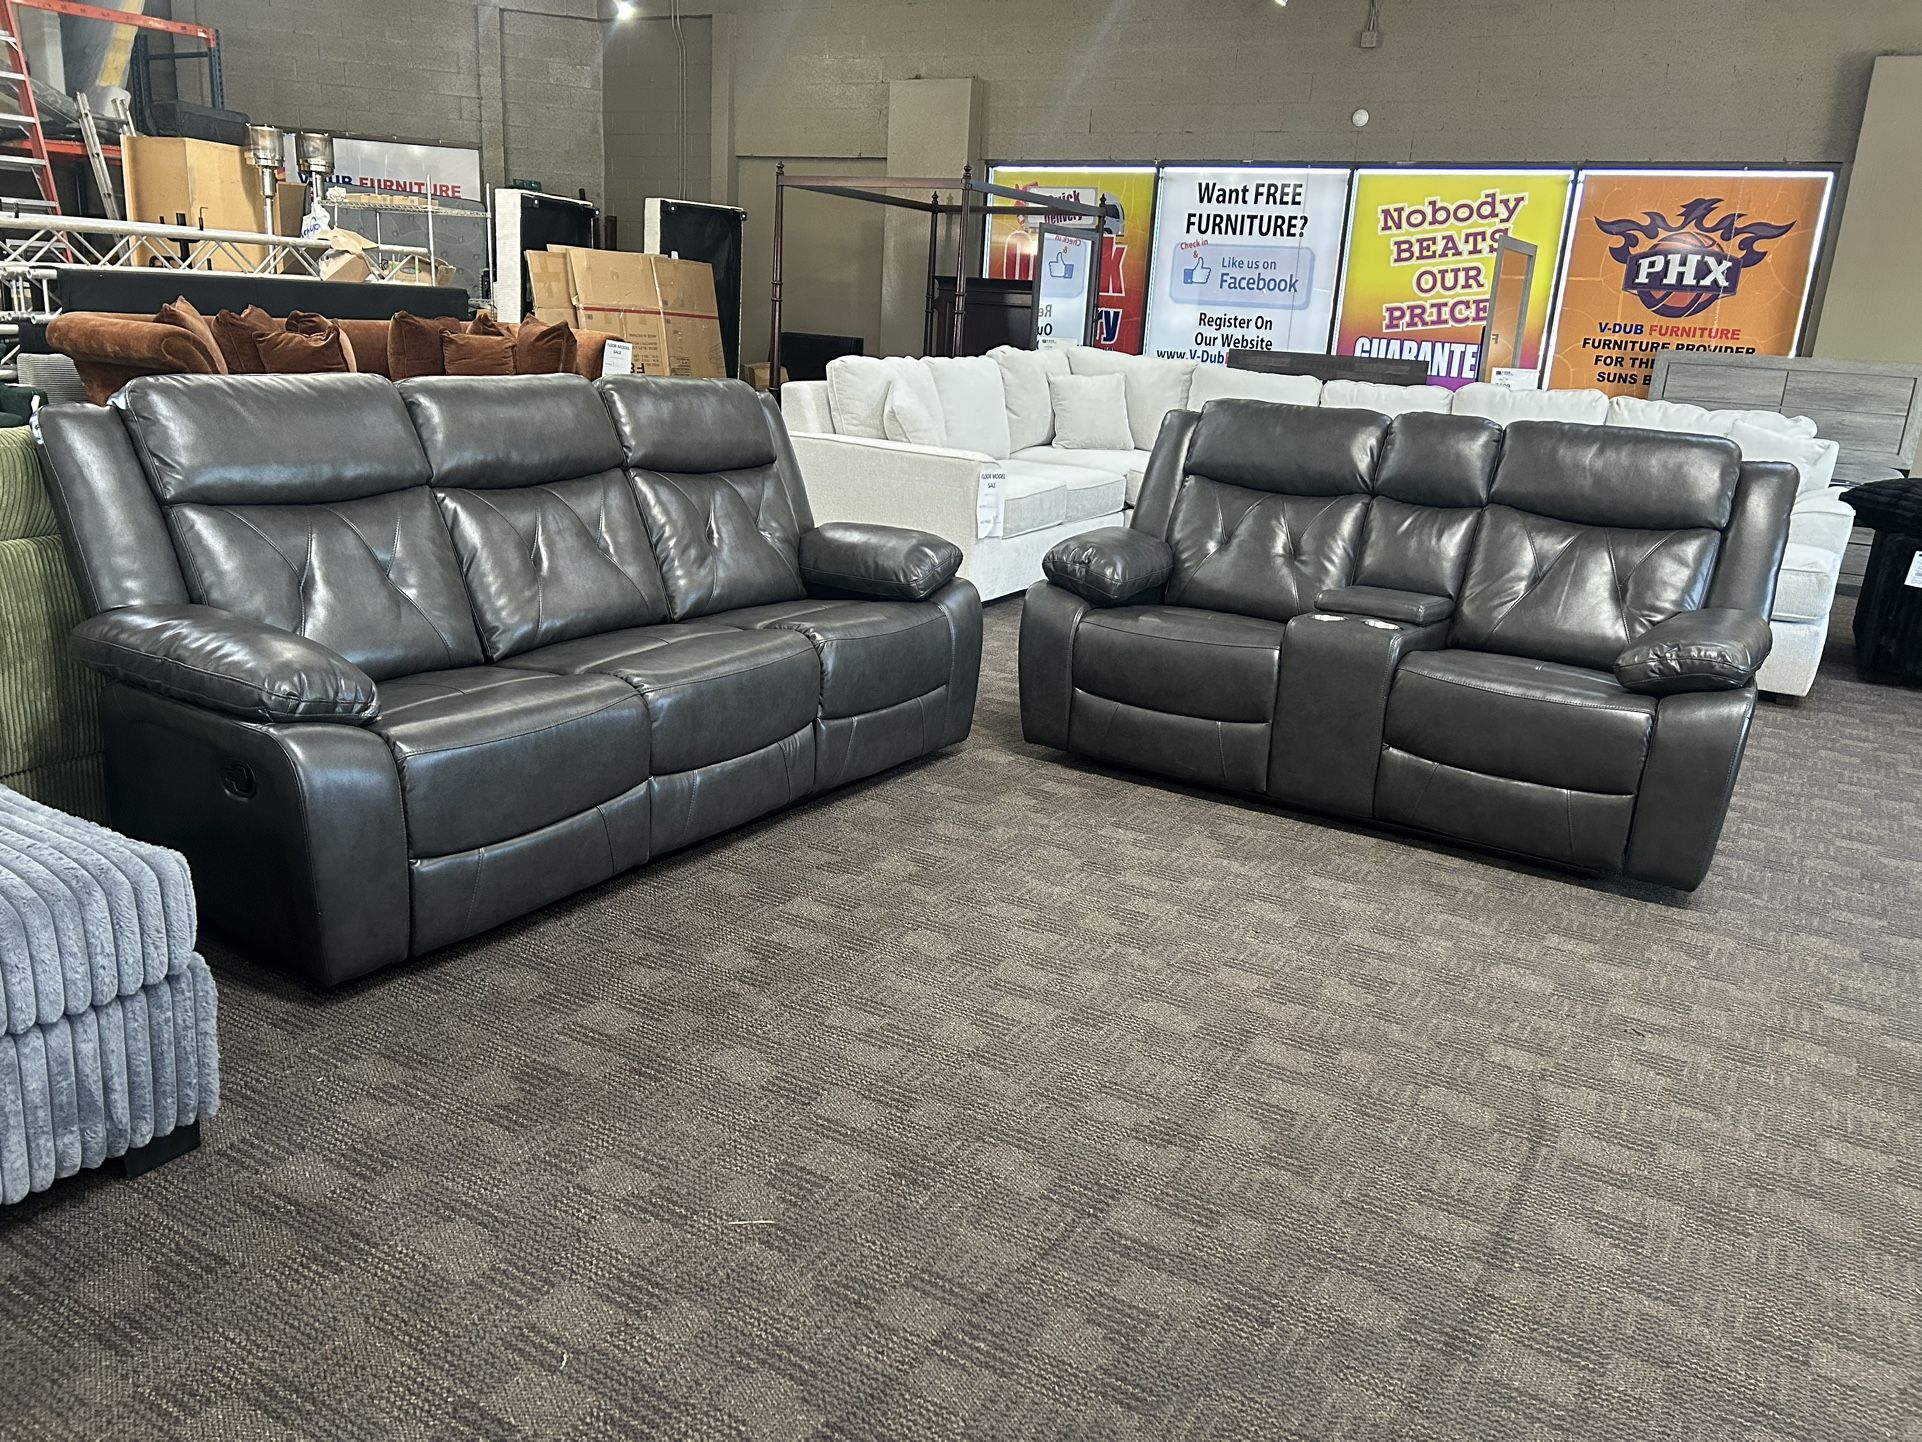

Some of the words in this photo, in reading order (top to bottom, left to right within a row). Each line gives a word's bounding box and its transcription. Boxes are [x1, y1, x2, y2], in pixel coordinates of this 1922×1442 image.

[298, 172, 353, 185] VUB
[1198, 182, 1249, 205] Want
[1253, 183, 1303, 206] FREE
[1380, 191, 1526, 232] Nobody
[1185, 213, 1308, 237] FURNITURE?
[1180, 240, 1201, 250] Check
[1201, 238, 1208, 246] in
[1392, 226, 1510, 264] BEATS
[1192, 250, 1199, 258] &
[1222, 257, 1244, 269] Like
[1247, 260, 1259, 270] us
[1262, 260, 1276, 270] on
[1634, 253, 1733, 287] PHX
[1219, 273, 1299, 293] Facebook
[1415, 266, 1484, 294] OUR
[1199, 312, 1252, 331] Register
[1255, 315, 1273, 331] On
[1194, 331, 1218, 347] Our
[1221, 333, 1273, 350] Website
[1599, 322, 1645, 335] V-DUB
[1649, 325, 1741, 341] FURNITURE
[1582, 338, 1671, 352] FURNITURE
[1675, 343, 1756, 355] PROVIDER
[1354, 336, 1480, 379] GUARANTE
[1594, 355, 1624, 367] FOR
[1596, 372, 1638, 384] SUNS
